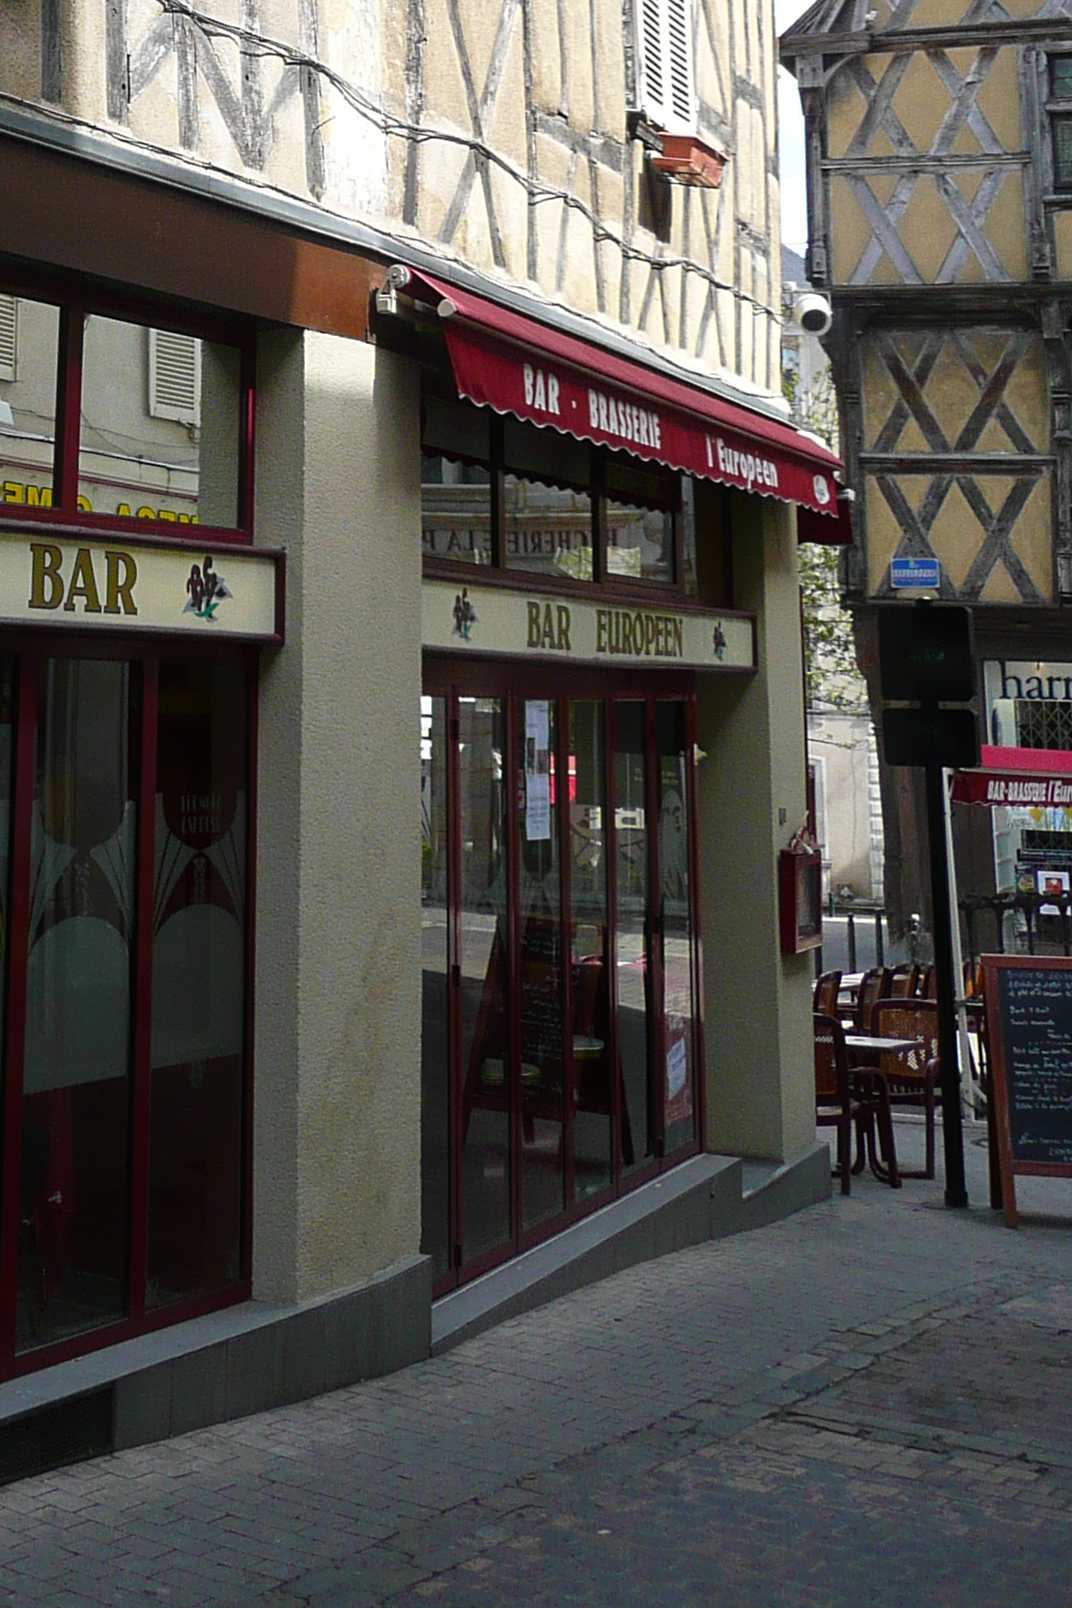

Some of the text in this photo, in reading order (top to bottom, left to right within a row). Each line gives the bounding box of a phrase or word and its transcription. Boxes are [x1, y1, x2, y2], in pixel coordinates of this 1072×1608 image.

[524, 363, 560, 415] BAR
[589, 388, 662, 449] BRASSERIE
[28, 543, 138, 615] BAR
[526, 601, 683, 657] BAR EUROPEEN
